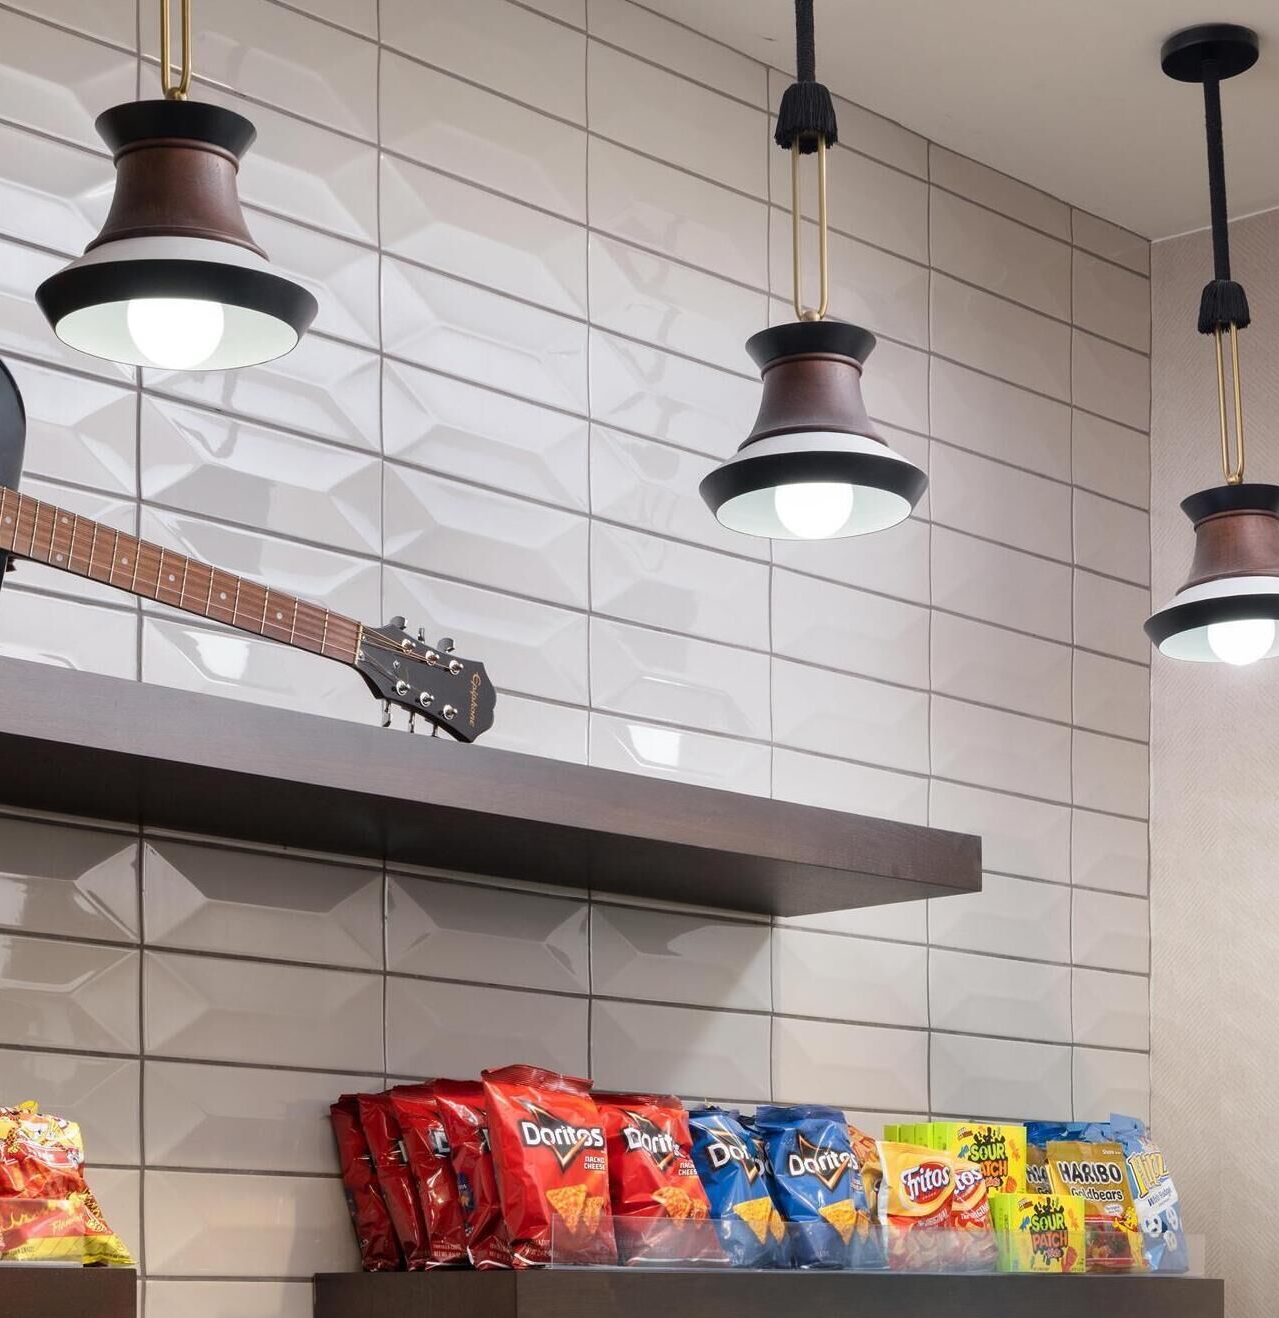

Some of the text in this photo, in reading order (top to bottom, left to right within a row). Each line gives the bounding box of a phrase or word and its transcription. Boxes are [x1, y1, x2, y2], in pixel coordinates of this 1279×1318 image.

[521, 1121, 604, 1148] Doritos
[970, 1143, 1006, 1161] SOUR
[788, 1149, 858, 1177] Doritos
[1057, 1161, 1122, 1184] HARIBO
[901, 1166, 951, 1202] Fritos
[1071, 1186, 1124, 1202] Goldbears
[1031, 1213, 1065, 1231] SOUR
[1031, 1232, 1068, 1249] PATCH
